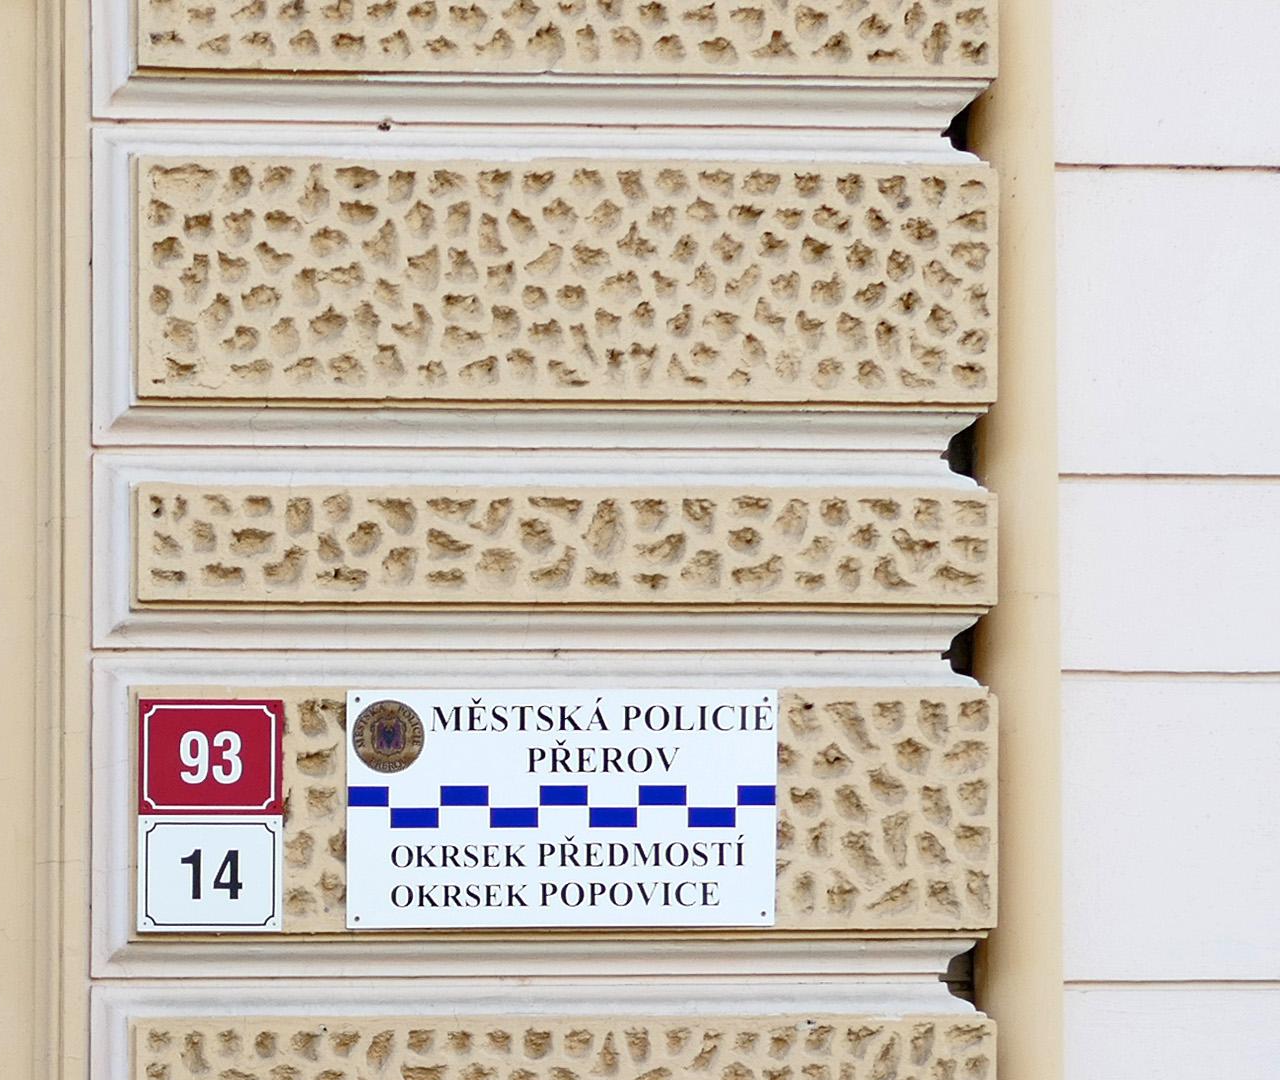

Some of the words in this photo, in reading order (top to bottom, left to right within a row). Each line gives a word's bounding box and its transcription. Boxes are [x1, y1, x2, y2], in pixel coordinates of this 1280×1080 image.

[431, 697, 609, 732] MĚSTSKÁ
[622, 704, 775, 732] POLICIE
[178, 730, 244, 785] 93
[527, 739, 681, 773] PŘEROV
[390, 844, 527, 868] OKRSEK
[537, 834, 746, 868] PŘEDMOSTÍ
[180, 848, 243, 900] 14
[390, 883, 529, 908] OKRSEK
[539, 881, 721, 907] POPOVICE
